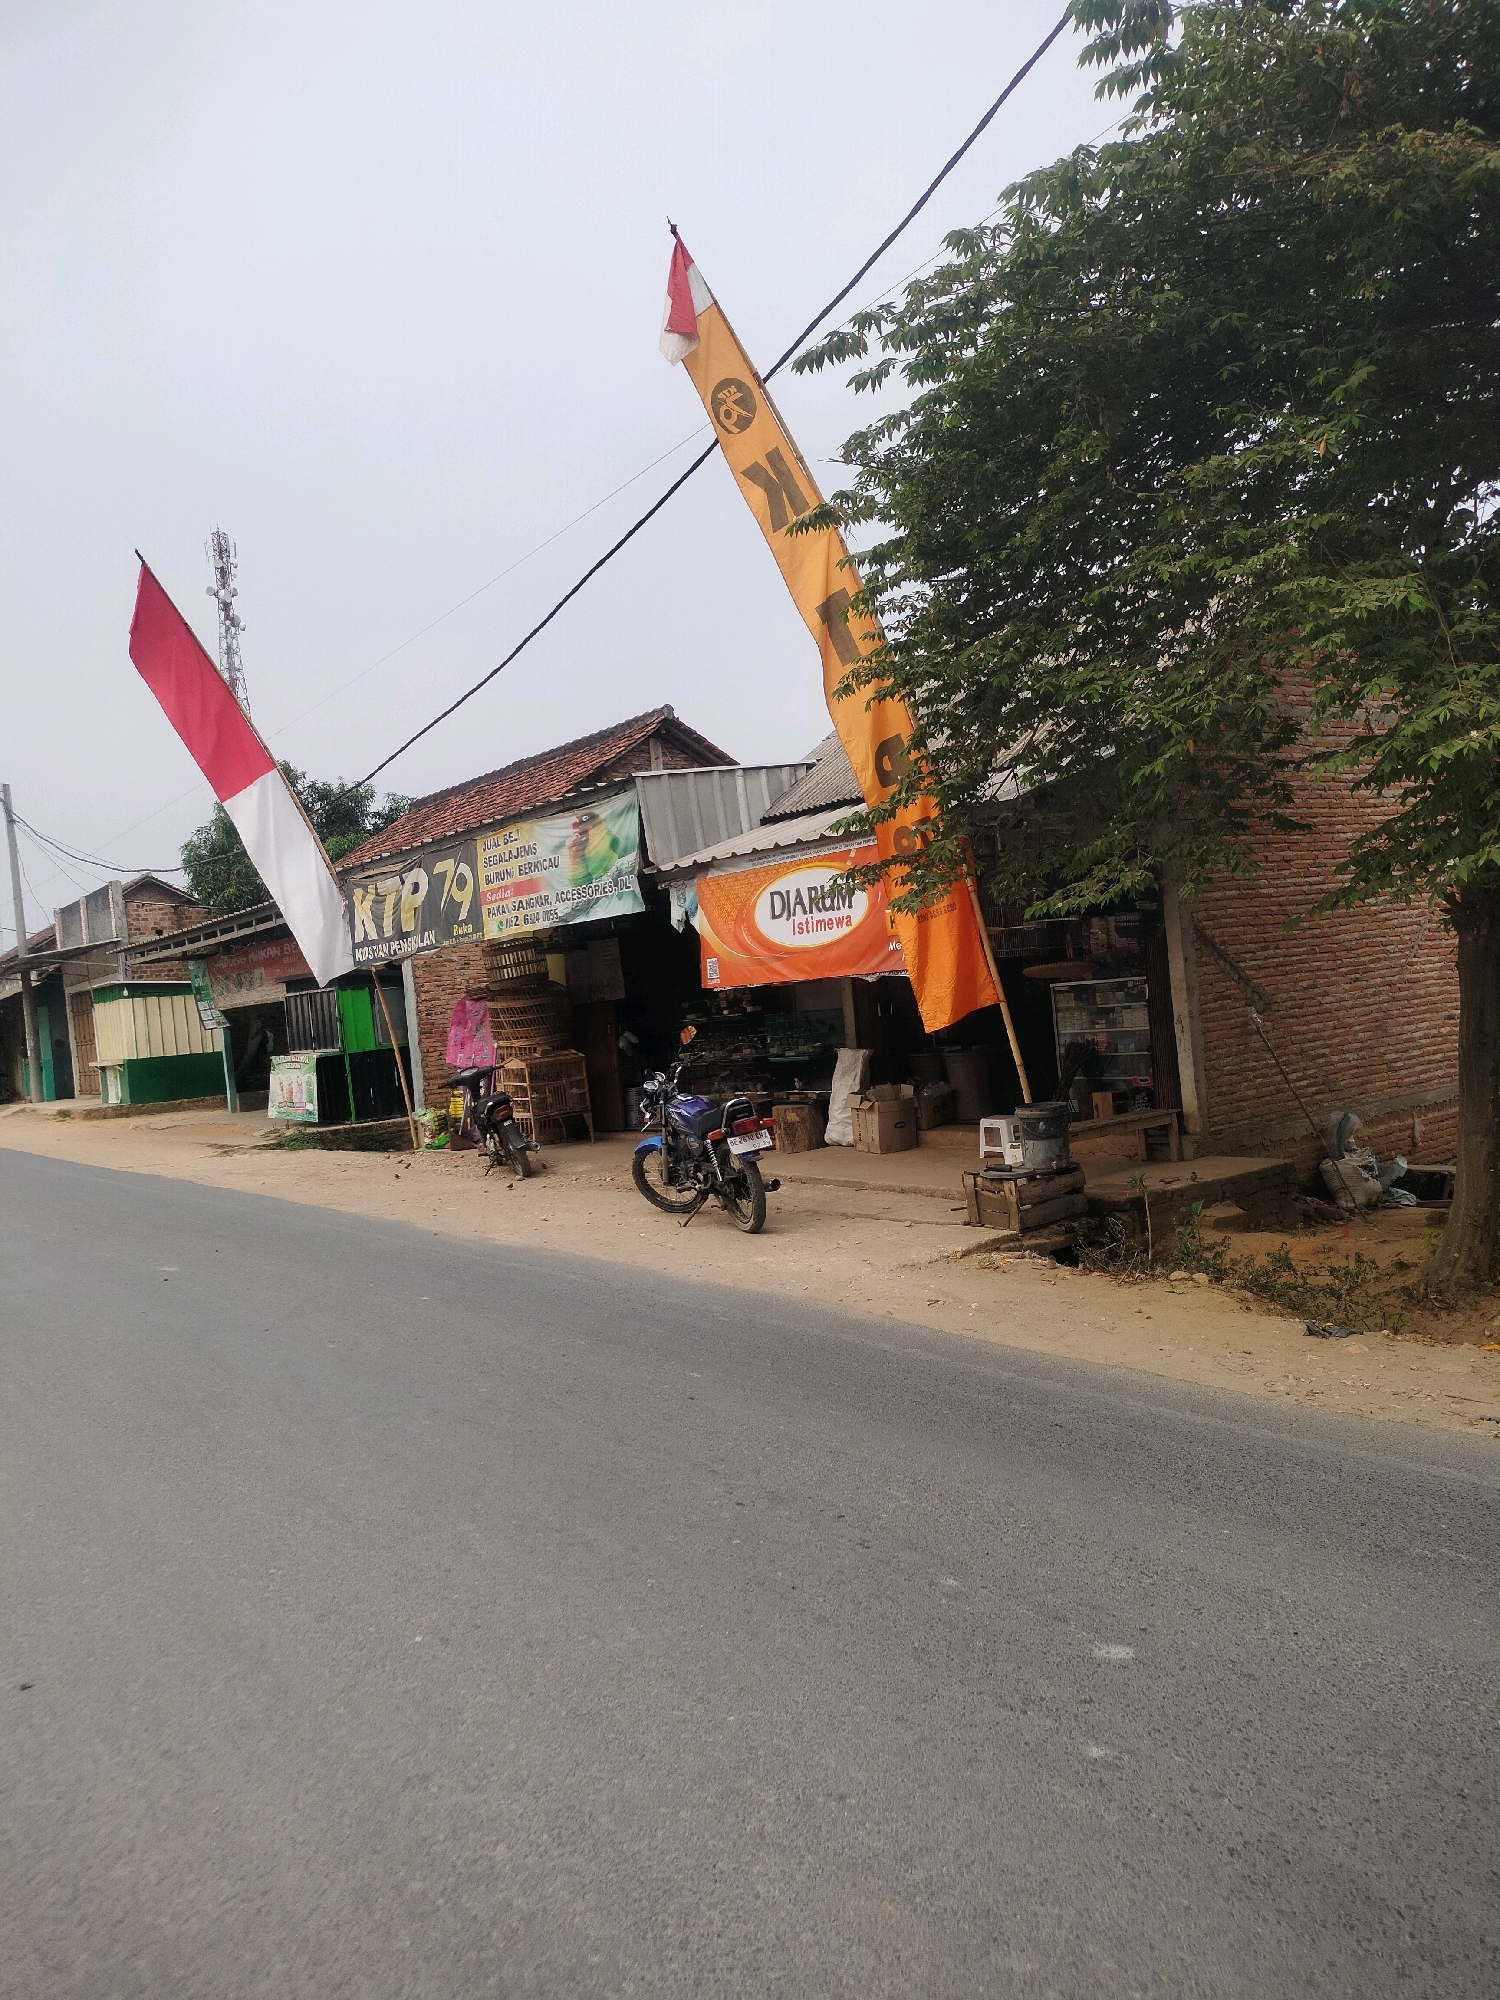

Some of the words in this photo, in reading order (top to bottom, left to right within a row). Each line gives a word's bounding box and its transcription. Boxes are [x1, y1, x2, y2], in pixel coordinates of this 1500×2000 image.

[482, 835, 501, 852] JUAL
[517, 855, 560, 877] BERKICAU
[353, 867, 429, 943] KTP
[432, 858, 474, 921] 79
[555, 880, 618, 905] ACCESSORIES,
[769, 883, 853, 921] DJARUM
[453, 922, 473, 936] Buka
[792, 914, 853, 936] Istimewa
